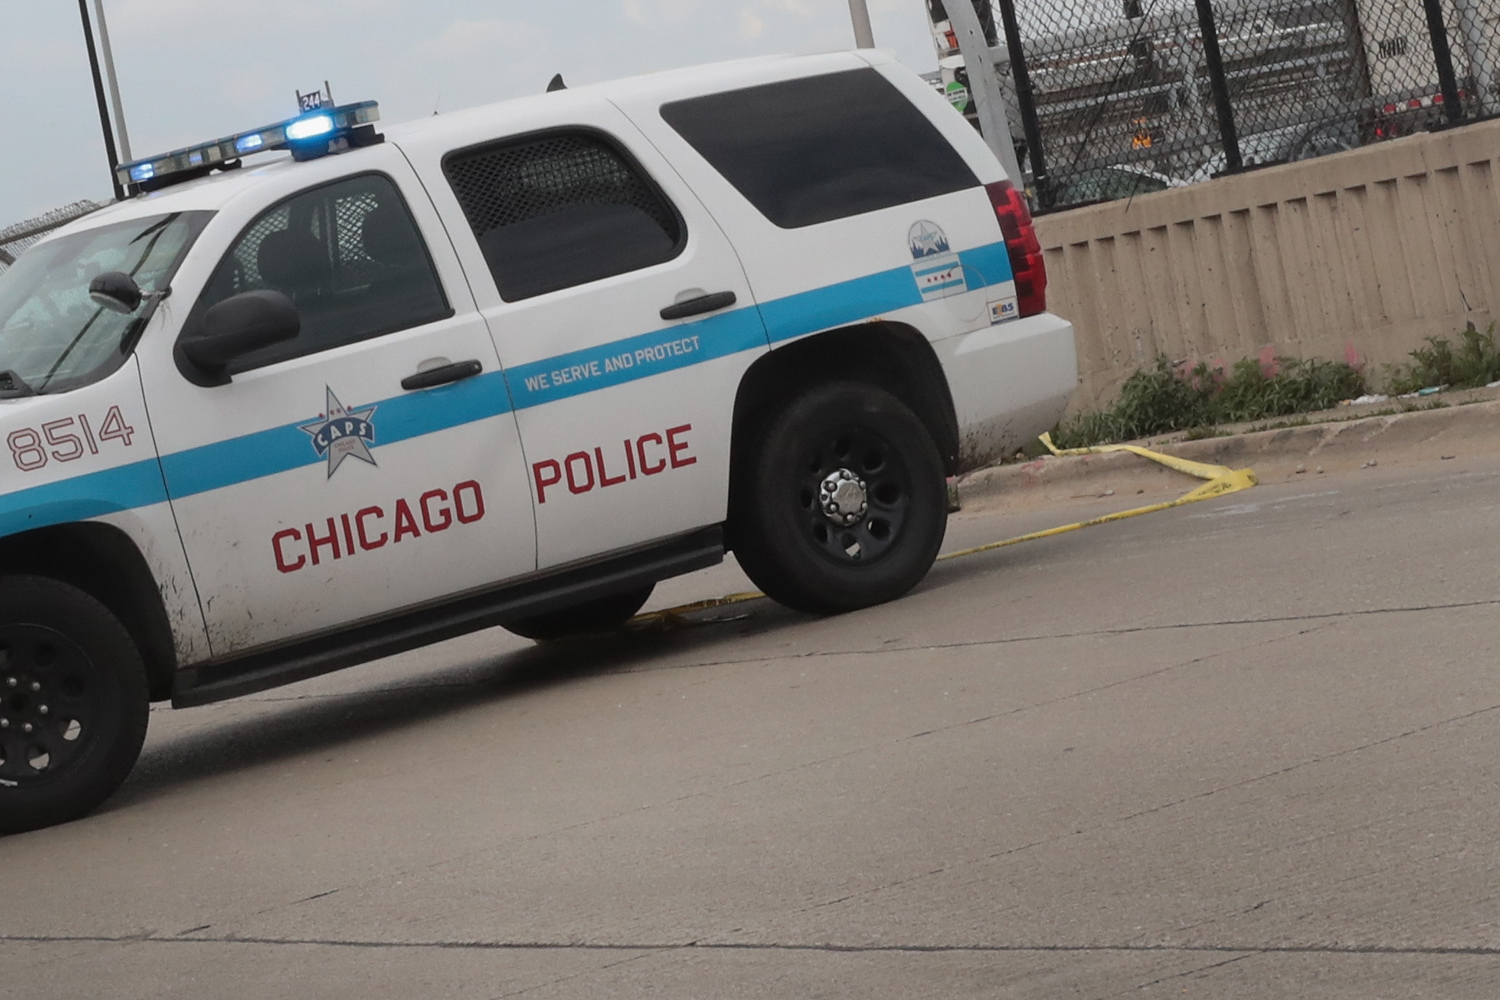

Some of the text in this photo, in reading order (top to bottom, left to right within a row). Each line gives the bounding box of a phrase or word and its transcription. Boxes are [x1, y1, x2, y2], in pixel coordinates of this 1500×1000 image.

[302, 92, 320, 111] 244
[524, 335, 700, 392] WE SERVE AND PROTECT
[6, 405, 135, 472] 8514
[317, 421, 367, 446] CAPS
[270, 423, 698, 574] CHICAGO POLICE
